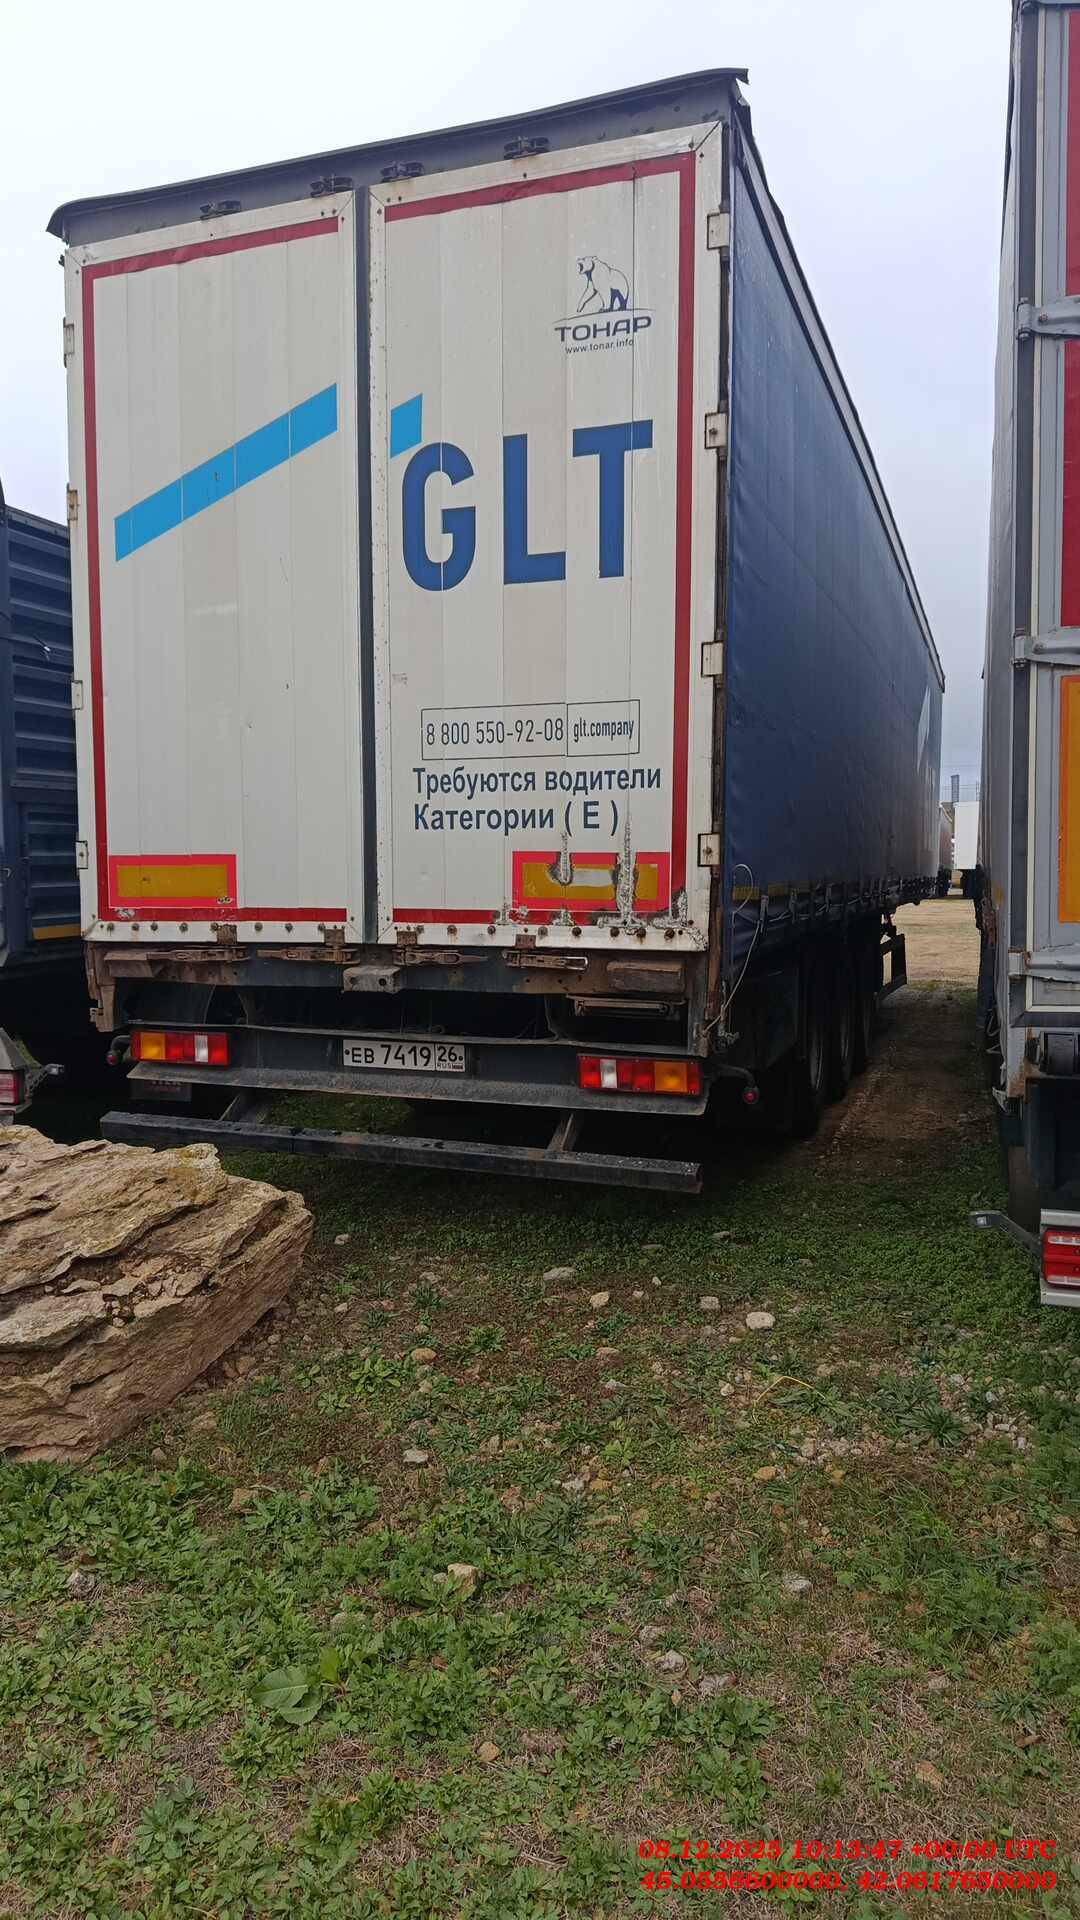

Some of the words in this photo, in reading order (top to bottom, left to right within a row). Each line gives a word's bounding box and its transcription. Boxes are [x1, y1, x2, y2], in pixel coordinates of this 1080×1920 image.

[554, 316, 652, 342] ТОНАР
[565, 339, 634, 354] www.tonar.info
[402, 419, 653, 592] GLT
[426, 722, 435, 746] 8
[441, 721, 470, 745] 800
[476, 718, 564, 744] 550-92-08
[573, 717, 635, 743] glt.company
[412, 766, 536, 799] Требуются
[545, 767, 662, 796] водители
[414, 803, 554, 836] Категории
[380, 1044, 431, 1067] 7419
[438, 1046, 457, 1062] 26
